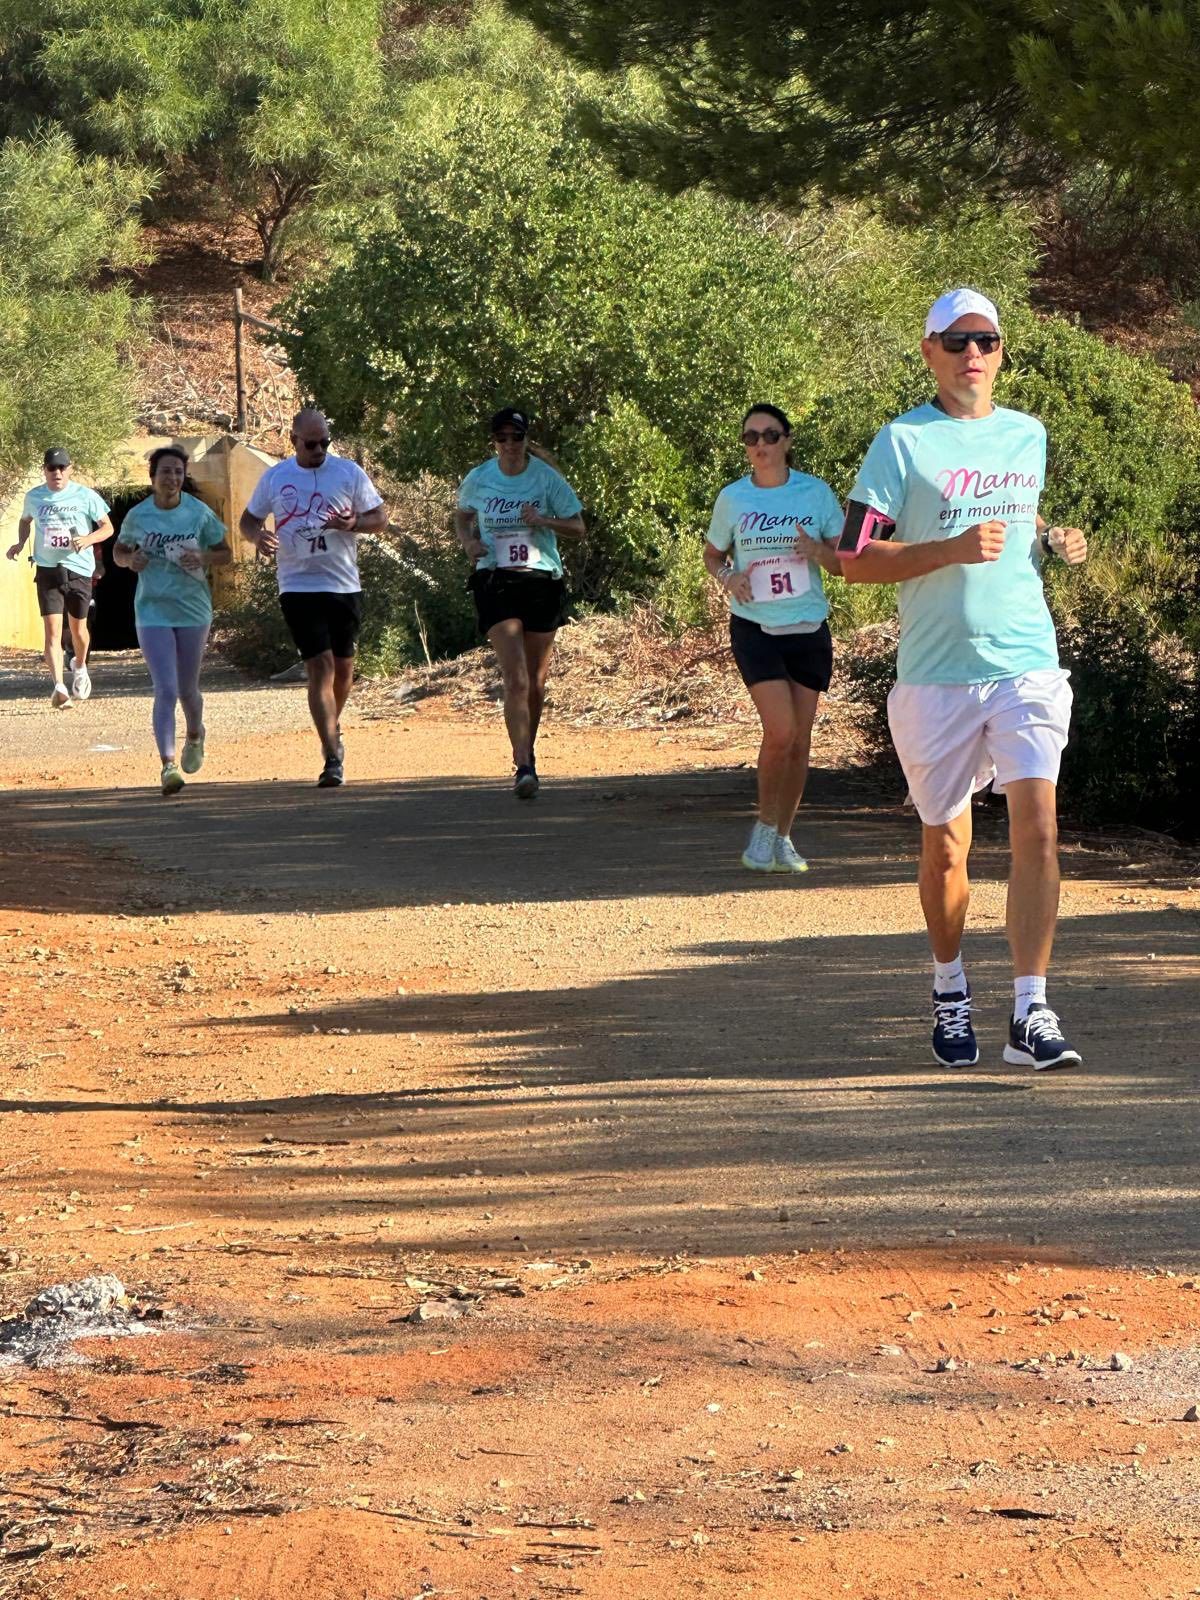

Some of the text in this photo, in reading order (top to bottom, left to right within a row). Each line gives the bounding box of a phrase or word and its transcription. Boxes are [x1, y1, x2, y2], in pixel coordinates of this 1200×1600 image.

[935, 467, 1038, 500] Mama
[38, 504, 79, 516] Mama
[940, 508, 961, 520] em
[739, 511, 814, 533] Mama
[51, 536, 70, 548] 313
[308, 536, 328, 554] 74
[509, 544, 529, 562] 58
[770, 571, 794, 595] 51
